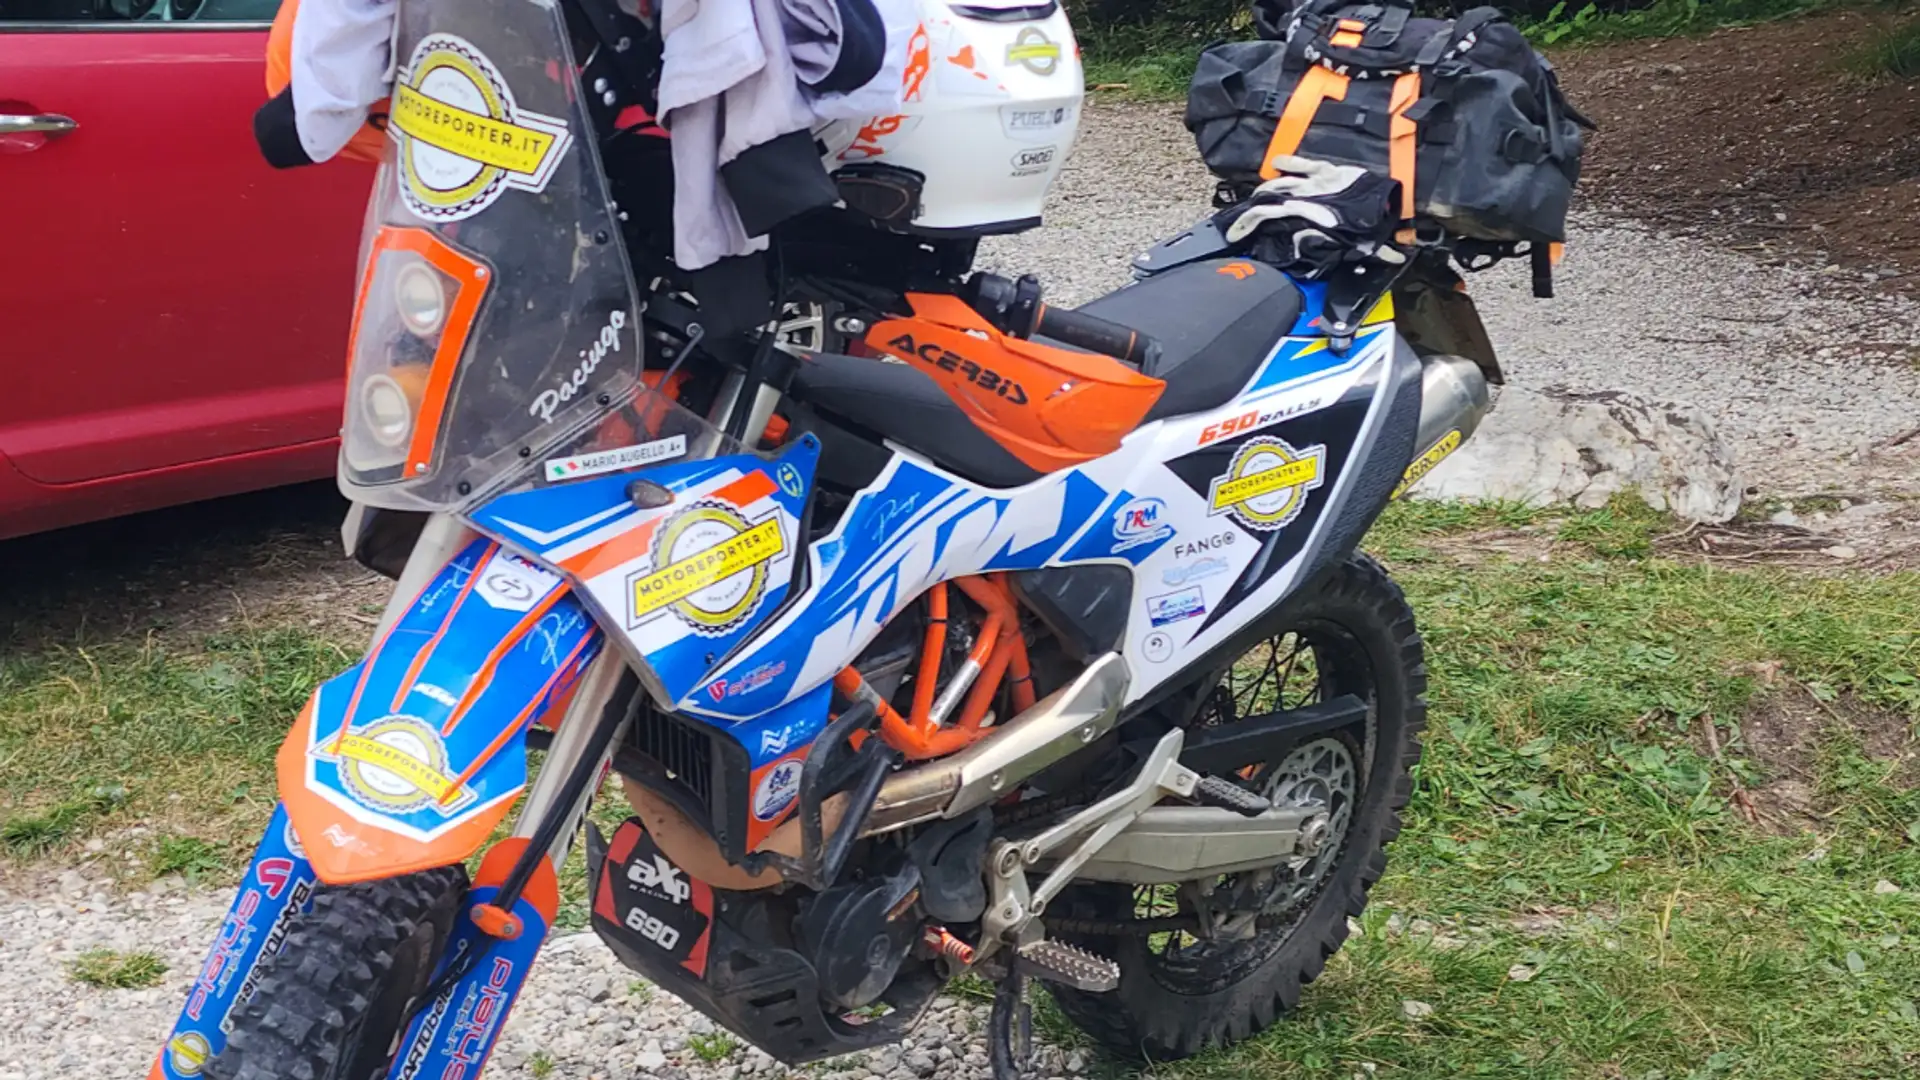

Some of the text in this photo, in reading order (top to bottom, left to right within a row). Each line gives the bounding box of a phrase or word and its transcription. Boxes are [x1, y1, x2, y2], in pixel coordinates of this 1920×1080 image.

[888, 334, 1028, 405] ACERBIS
[1198, 398, 1322, 446] 690 RALLY
[582, 455, 617, 470] MARIO
[620, 445, 665, 463] AUGELLO
[1219, 460, 1315, 497] MOTOREPORTER.IT
[1124, 504, 1157, 531] PRM
[640, 525, 778, 596] MOTOREPORTER.IT
[1174, 531, 1235, 559] FANGO
[626, 907, 680, 950] 690
[187, 889, 261, 1022] shield
[440, 956, 514, 1080] shield
